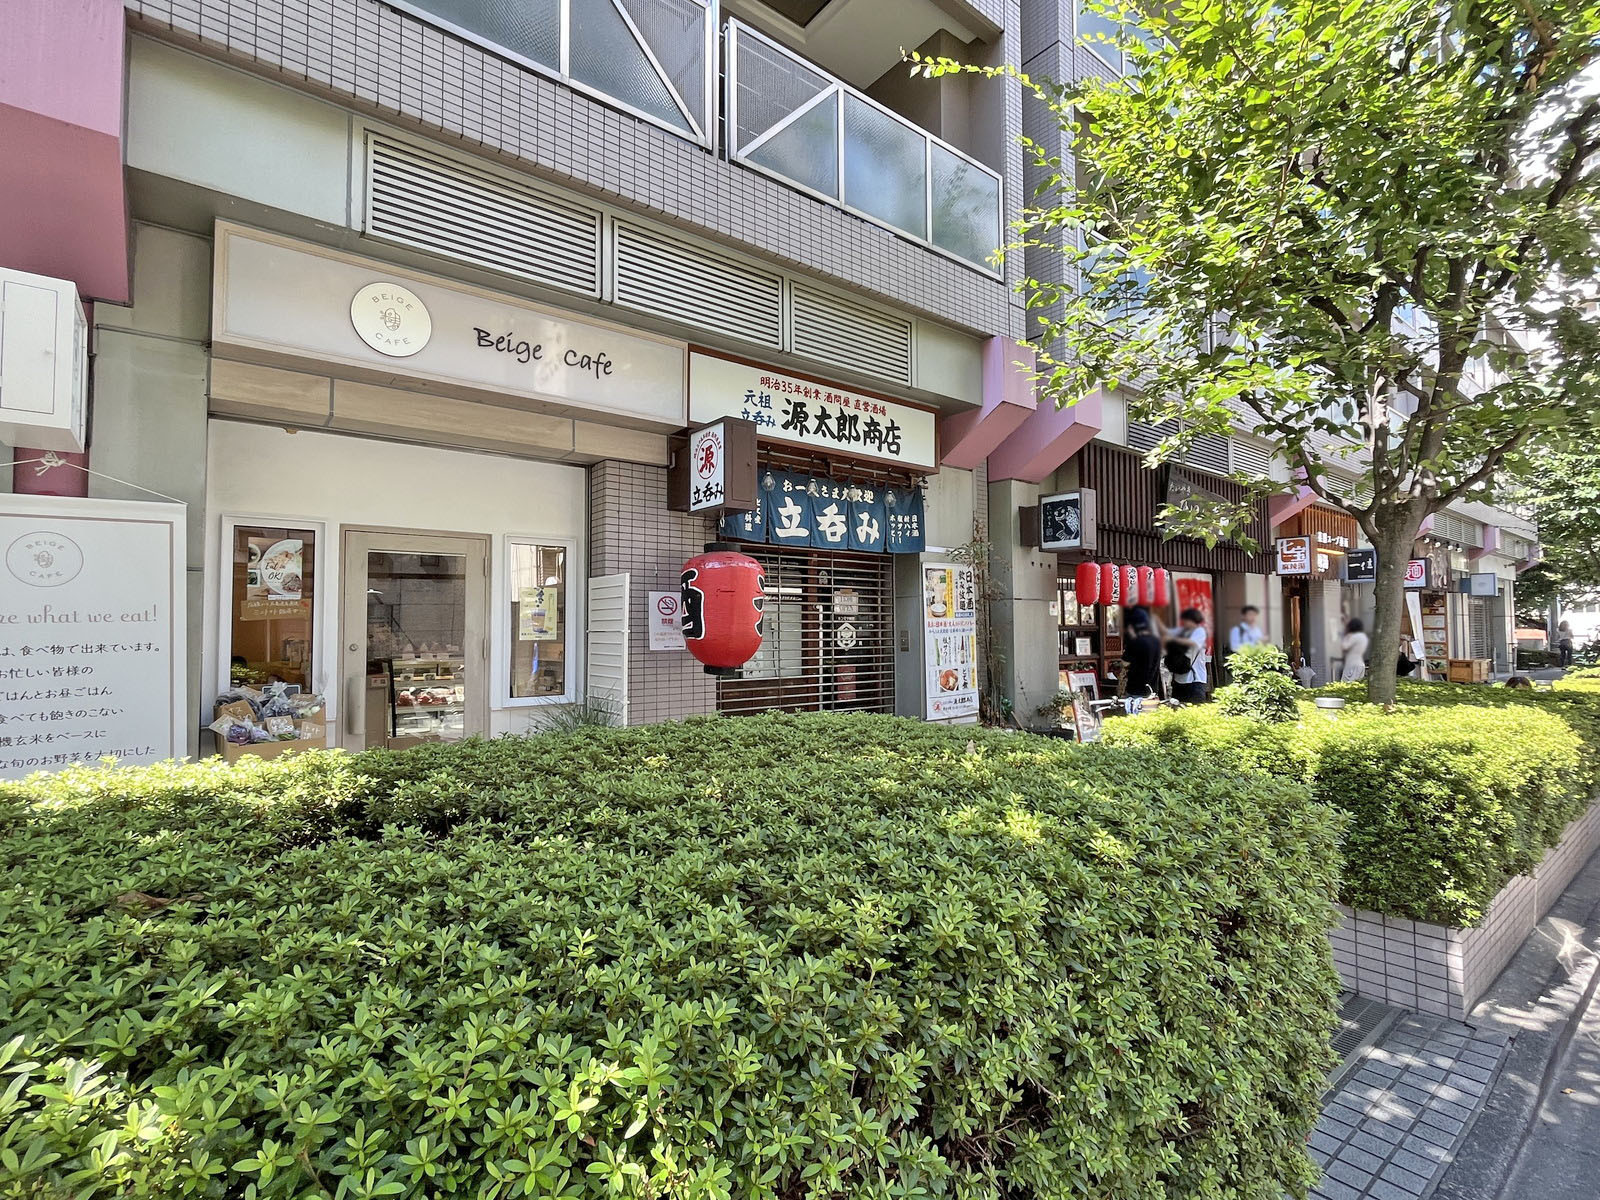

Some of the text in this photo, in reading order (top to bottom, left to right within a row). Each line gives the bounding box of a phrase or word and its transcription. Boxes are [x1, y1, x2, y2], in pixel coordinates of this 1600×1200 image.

[371, 293, 415, 311] BEIGE
[375, 332, 412, 346] CAFE
[473, 327, 543, 364] Beige
[743, 389, 773, 410] 元祖
[760, 375, 888, 417] 明治35年創業 酒問屋 直営酒場
[740, 407, 777, 429] 立呑み
[780, 397, 903, 457] 源太郎商店
[699, 444, 715, 474] 源
[692, 481, 724, 507] 立呑み
[775, 496, 881, 545] 立呑み
[25, 540, 65, 551] BEIGE
[29, 570, 65, 579] CAFE
[966, 570, 974, 611] 日本酒
[27, 604, 82, 624] what
[88, 611, 113, 623] we
[120, 604, 158, 623] eat!
[0, 642, 161, 657] は、食べ物で出来ています。
[0, 665, 94, 680] お忙しい皆様の
